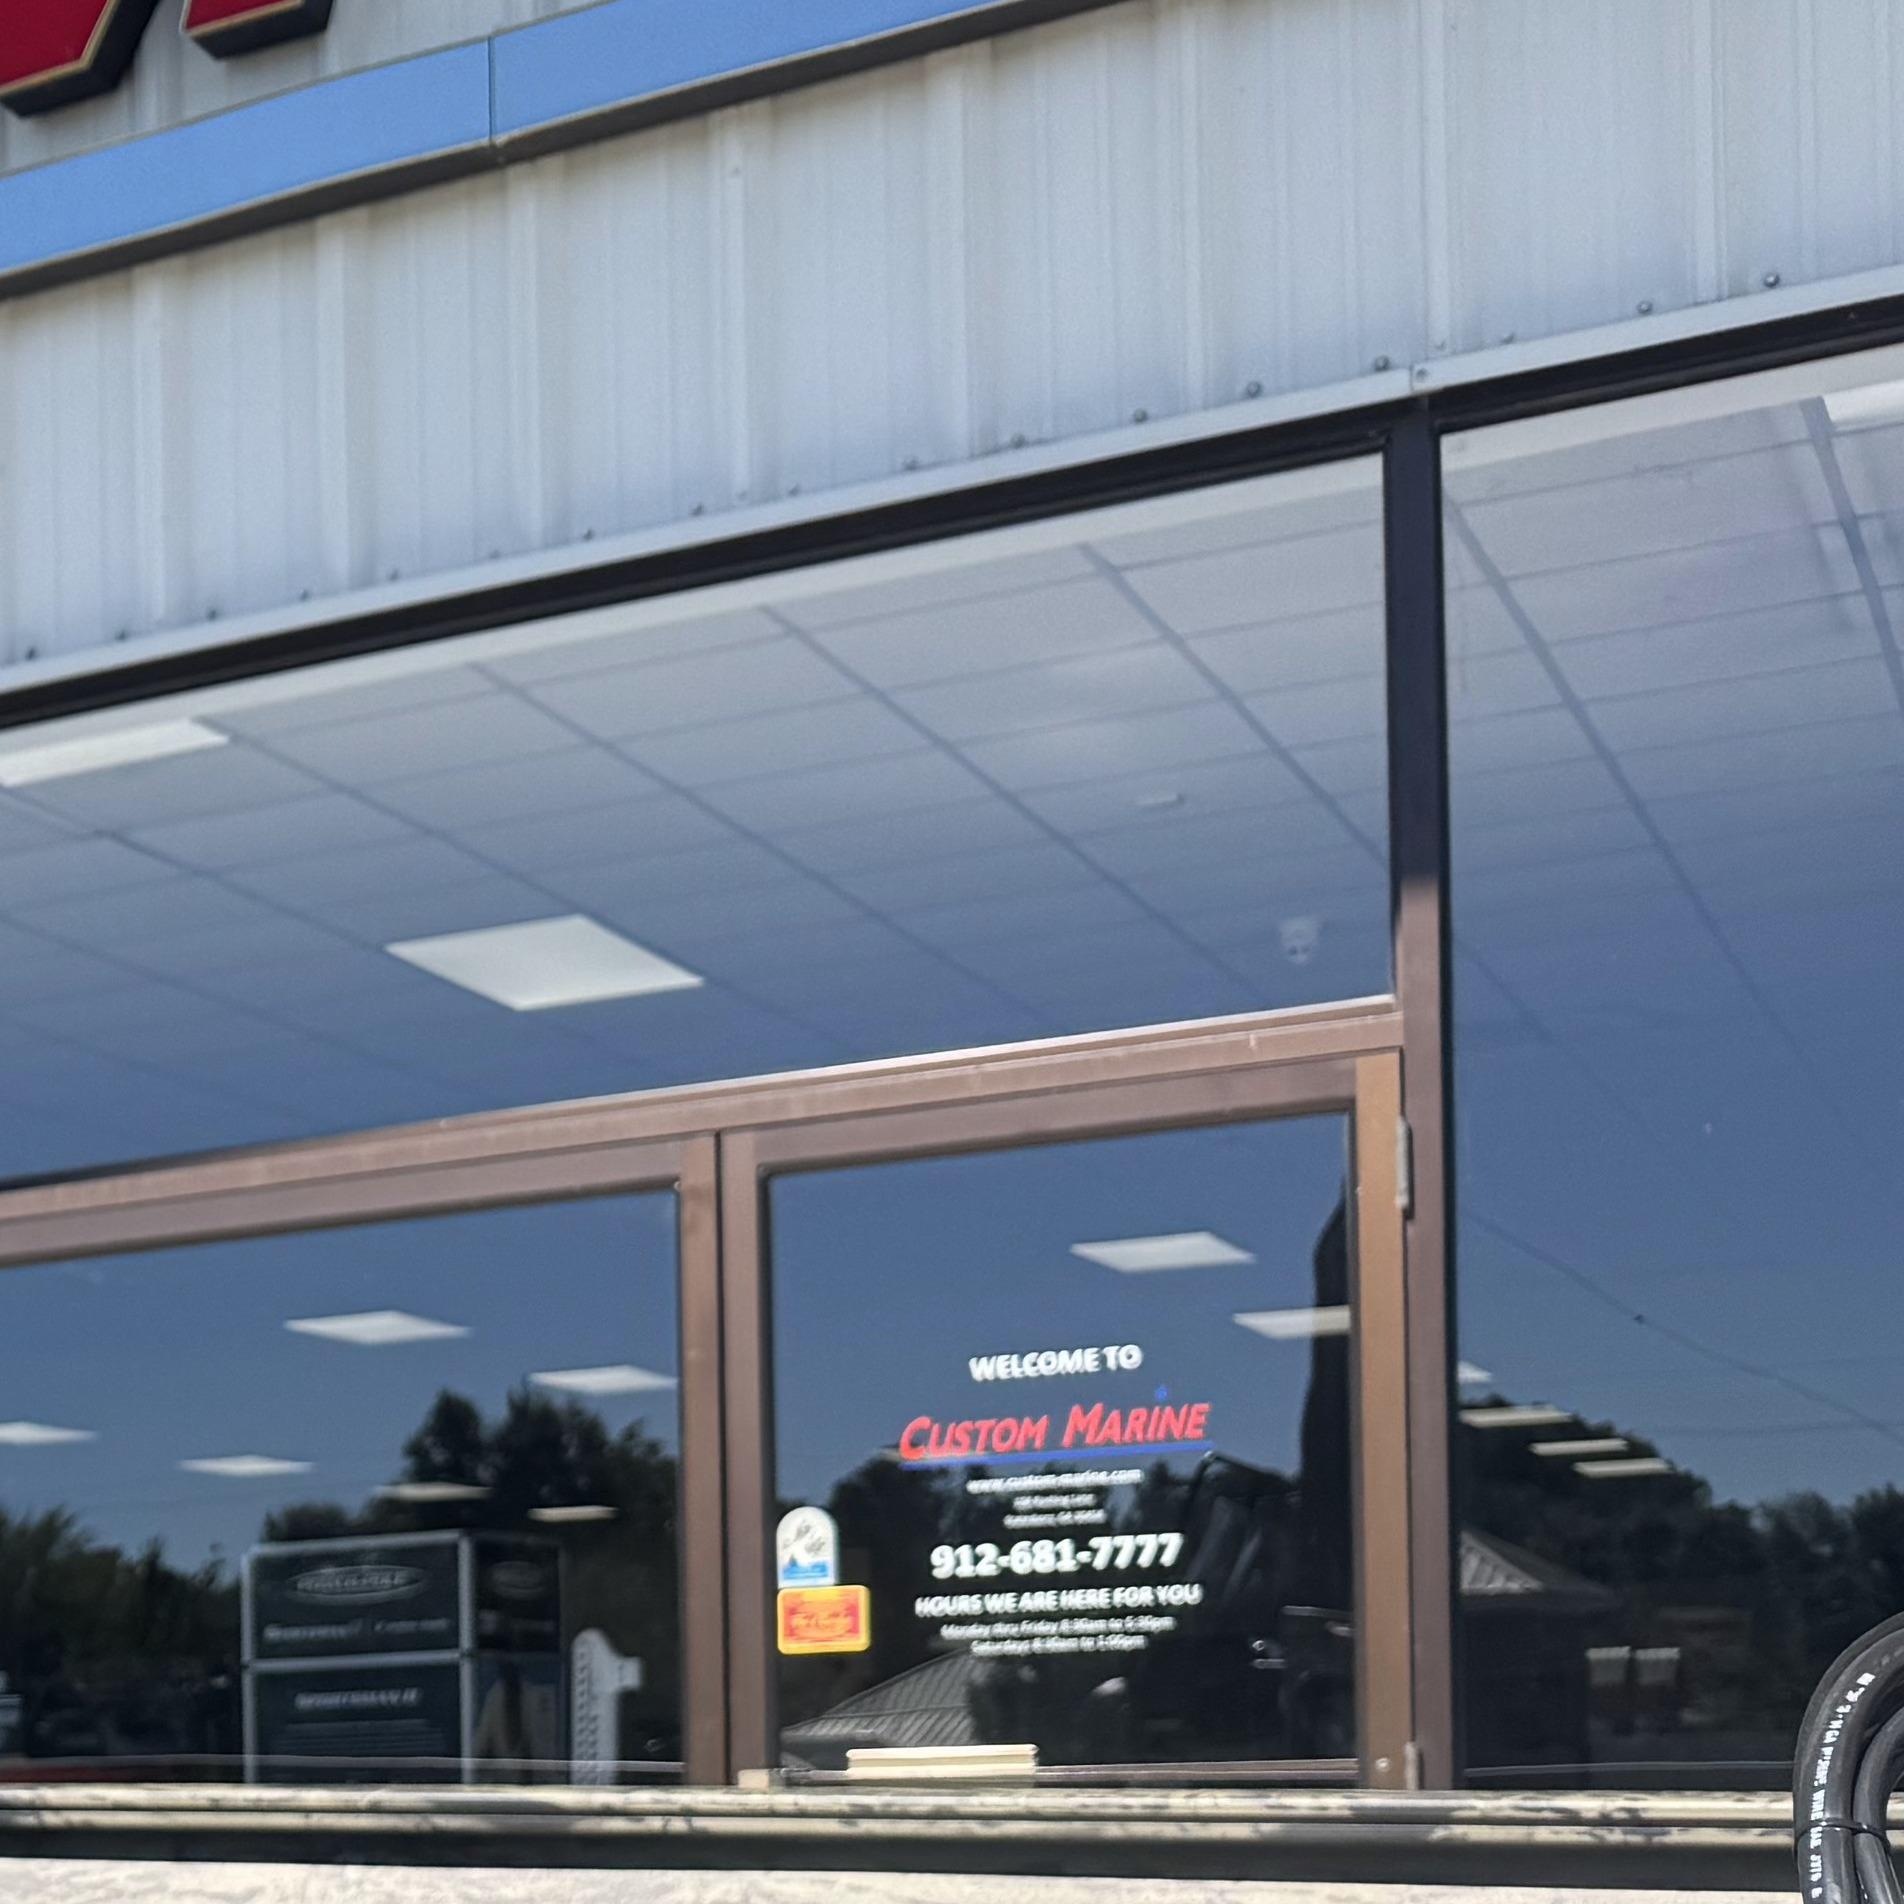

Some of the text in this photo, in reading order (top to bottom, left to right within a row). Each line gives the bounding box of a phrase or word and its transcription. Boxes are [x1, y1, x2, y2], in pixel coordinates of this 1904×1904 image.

[969, 1344, 1143, 1382] WELCOME TO
[900, 1402, 1211, 1460] CUSTOM MARINE
[930, 1532, 1184, 1579] 912-681-7777
[915, 1583, 1203, 1618] HOURS WE ARE HERE FOR YOU
